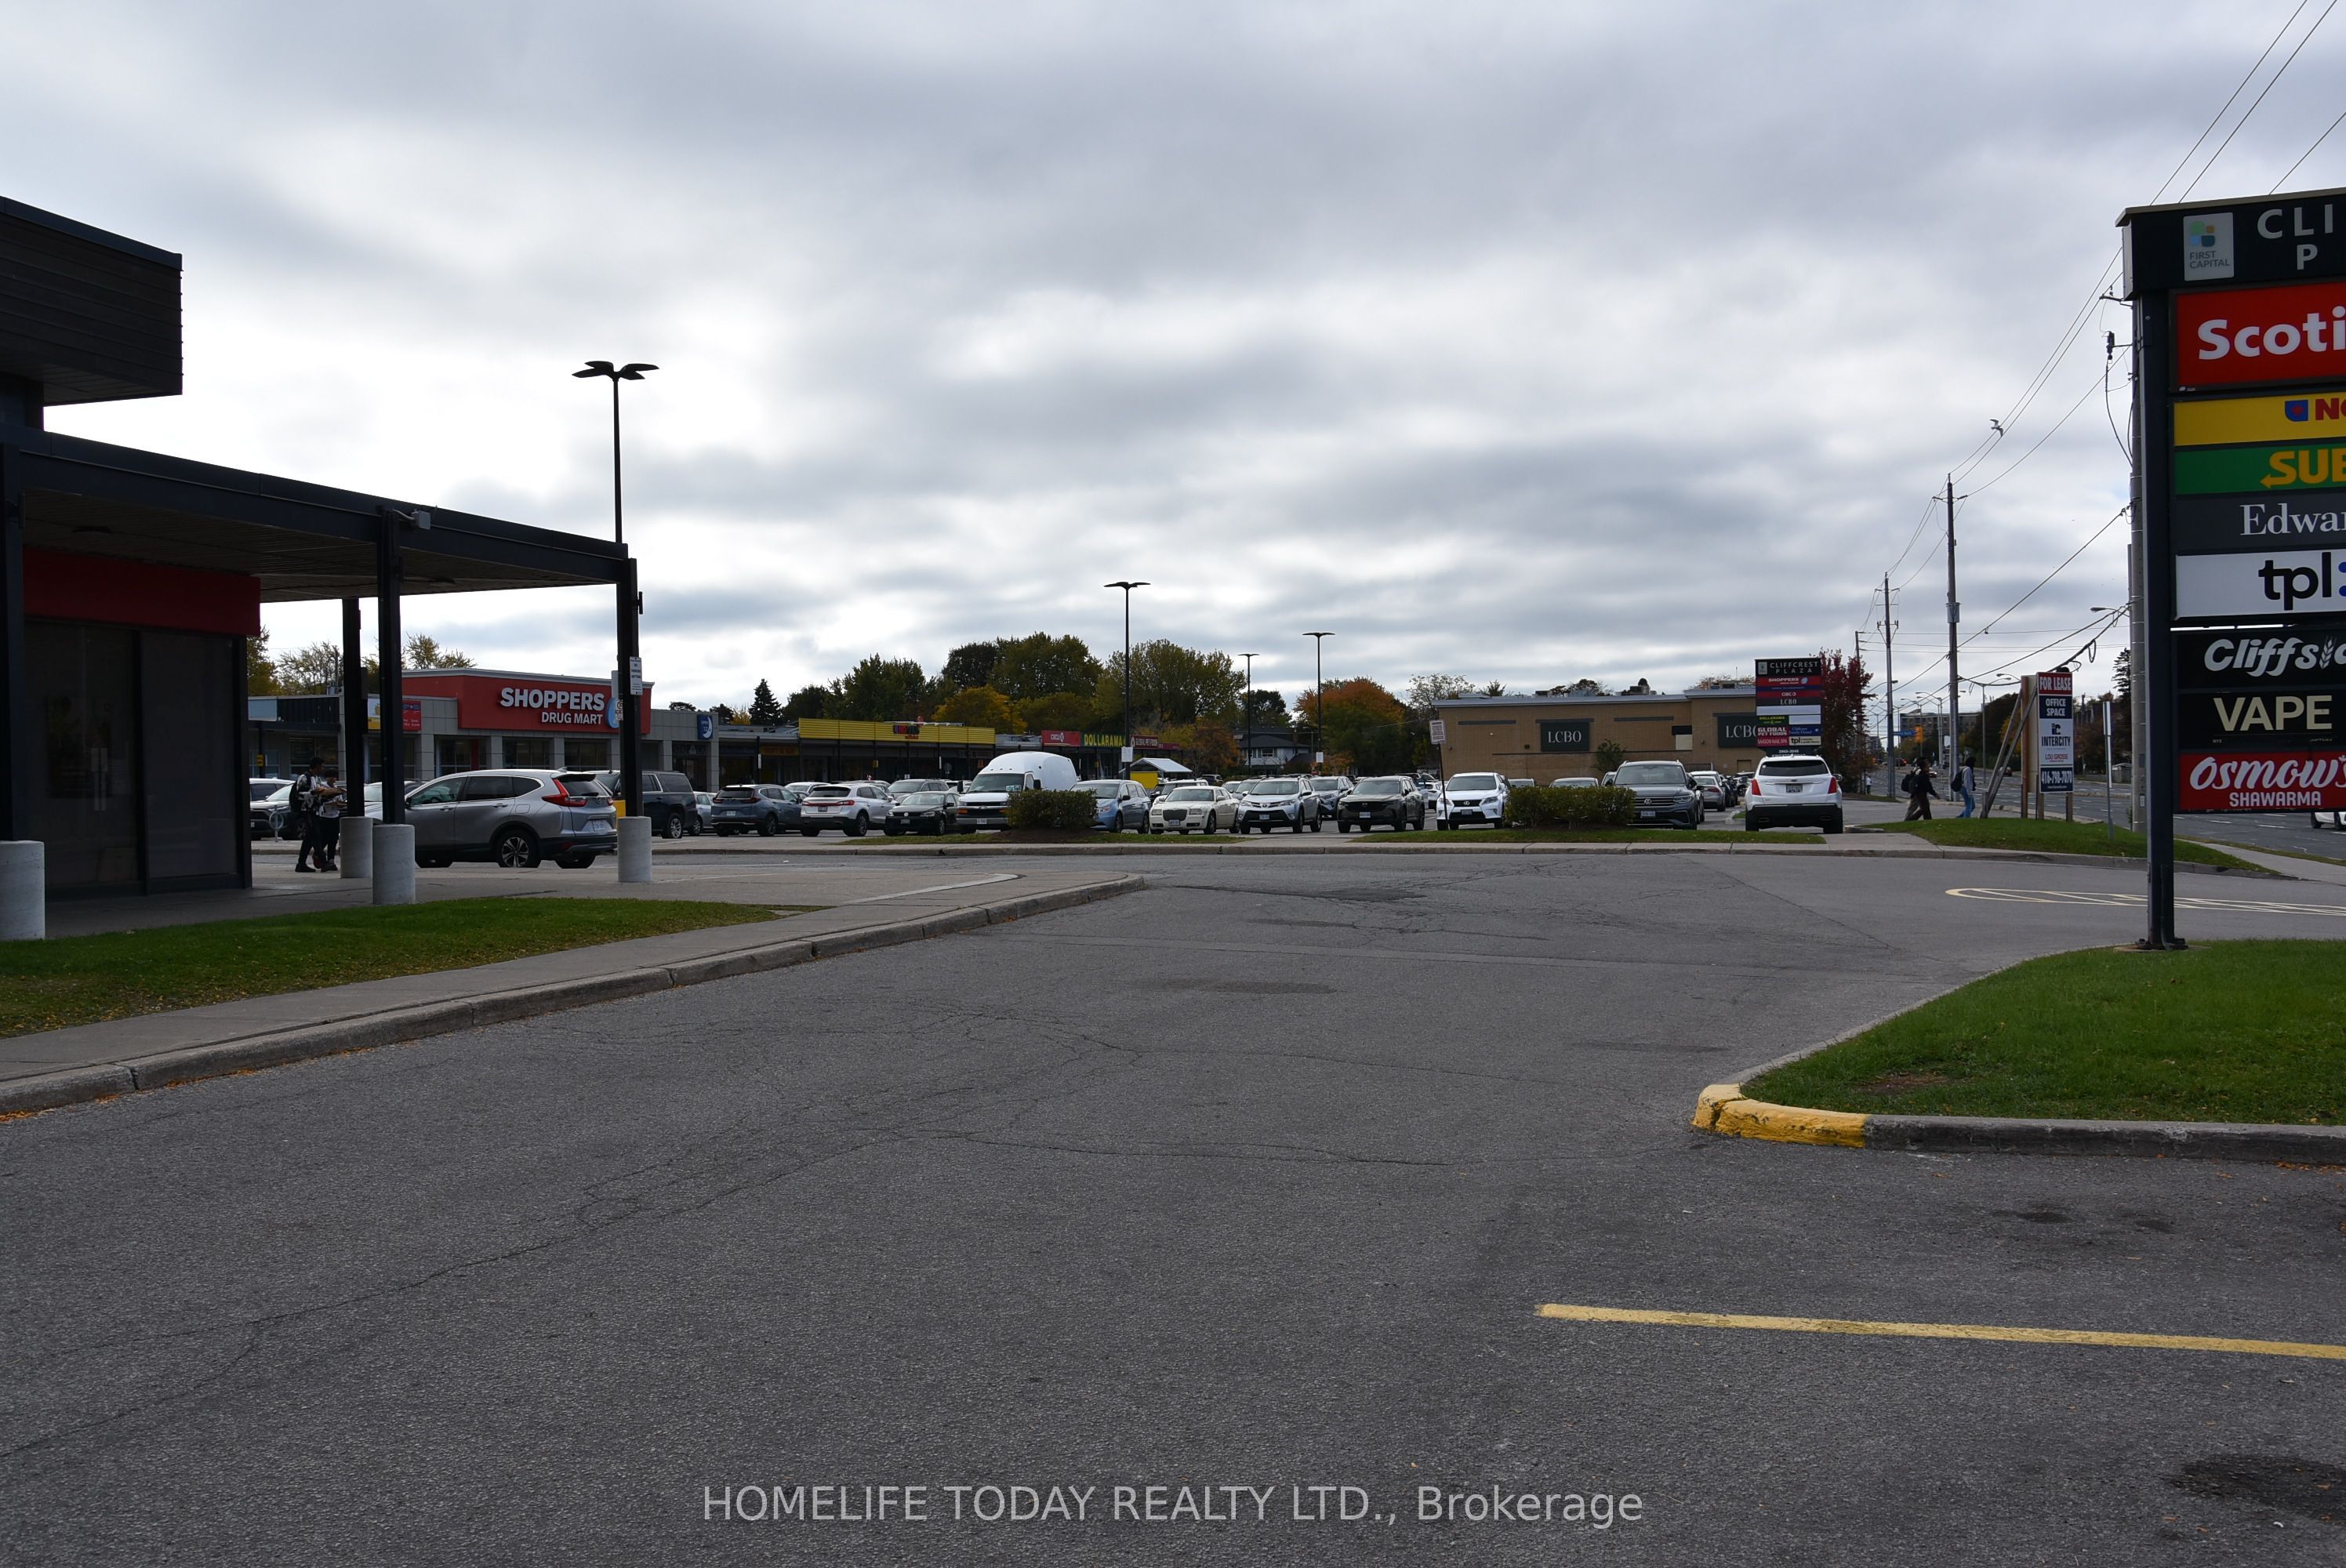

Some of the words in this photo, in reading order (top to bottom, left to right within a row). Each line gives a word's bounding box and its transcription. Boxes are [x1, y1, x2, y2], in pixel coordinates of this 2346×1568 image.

[2257, 204, 2333, 239] CLI
[2189, 251, 2217, 260] FIRST
[2296, 244, 2318, 270] P
[2189, 259, 2230, 269] CAPITAL
[2197, 306, 2346, 360] Scoti
[2315, 397, 2346, 421] N
[2039, 677, 2052, 690] FOR
[2054, 677, 2072, 691] LEASE
[499, 687, 605, 711] SHOPPERS
[541, 712, 572, 724] DRUG
[574, 713, 603, 724] MART
[2213, 695, 2333, 731] VAPE
[1084, 734, 1123, 746] DOLLARAMA
[1548, 731, 1582, 743] LCBO
[2041, 736, 2071, 746] INTERCITY
[2229, 791, 2322, 807] SHAWARMA
